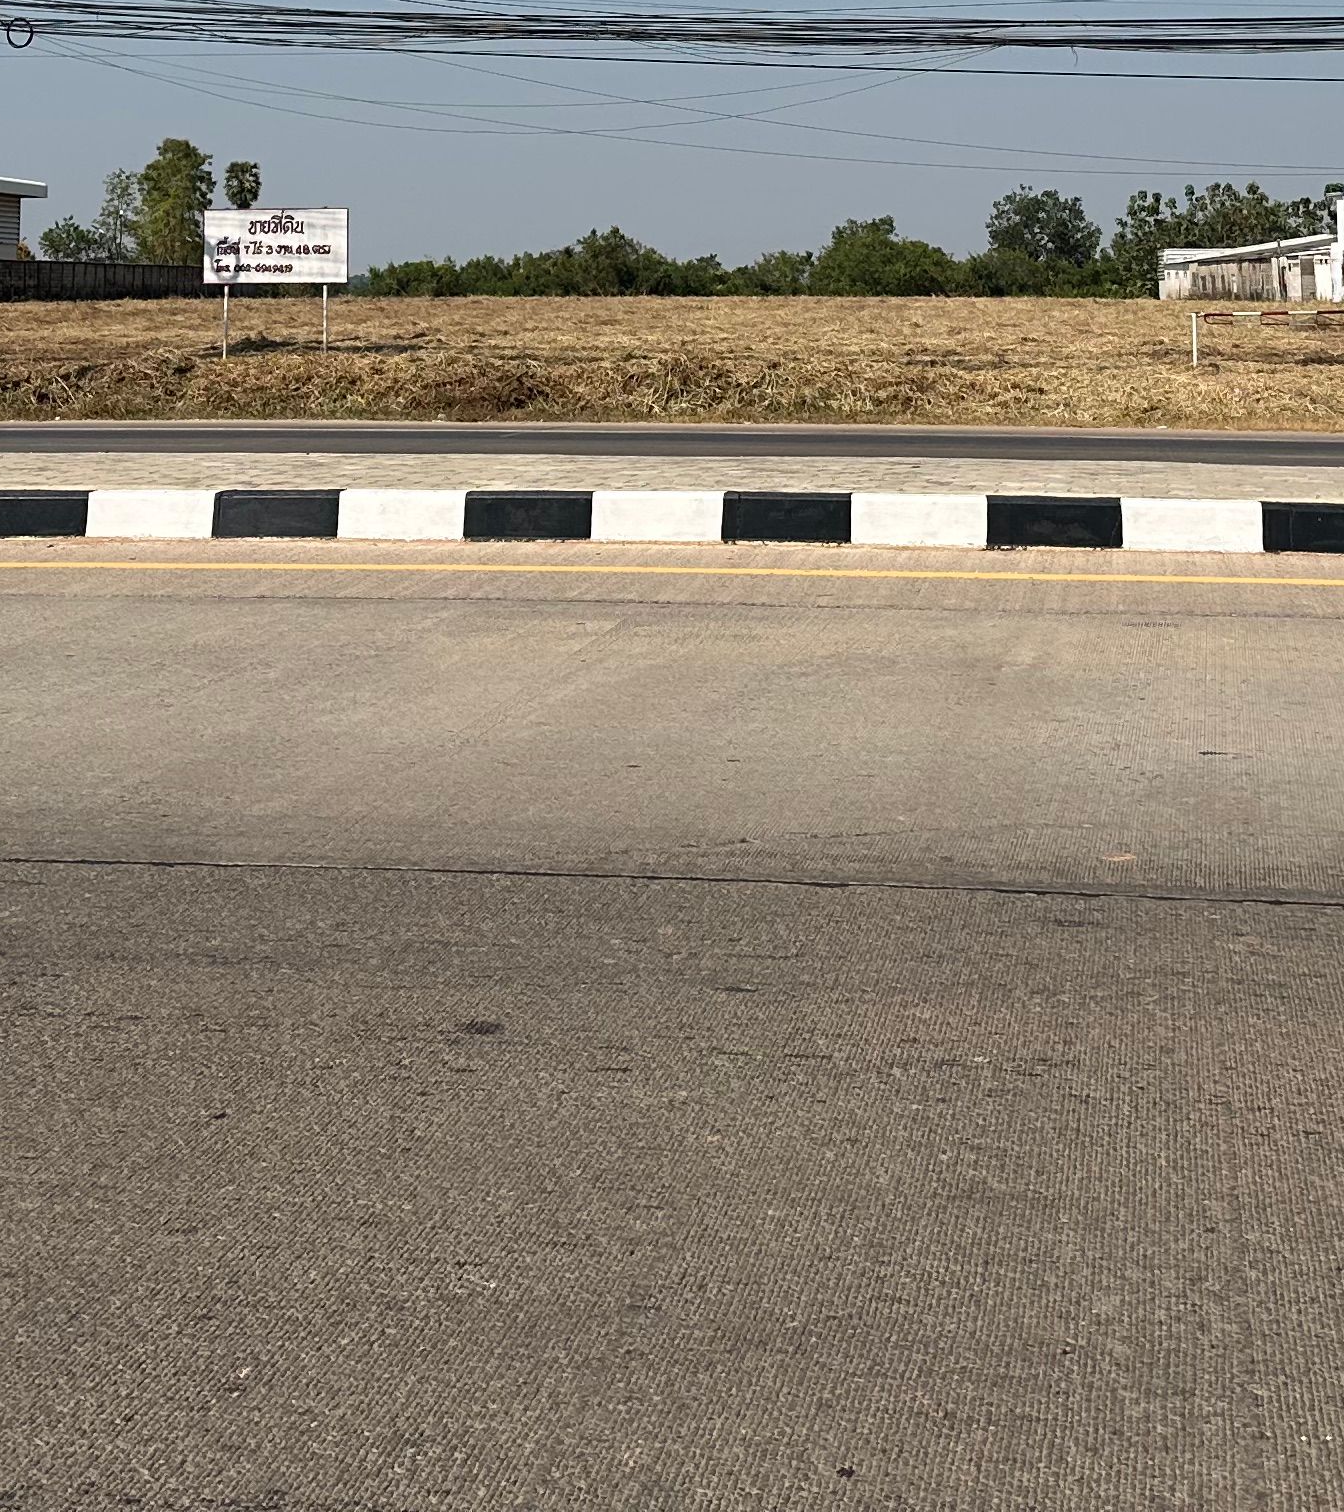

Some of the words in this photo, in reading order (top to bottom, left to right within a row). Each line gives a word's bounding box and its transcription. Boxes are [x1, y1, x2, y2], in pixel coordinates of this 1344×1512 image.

[248, 210, 305, 236] ขายที่ดิน
[265, 244, 274, 255] 3
